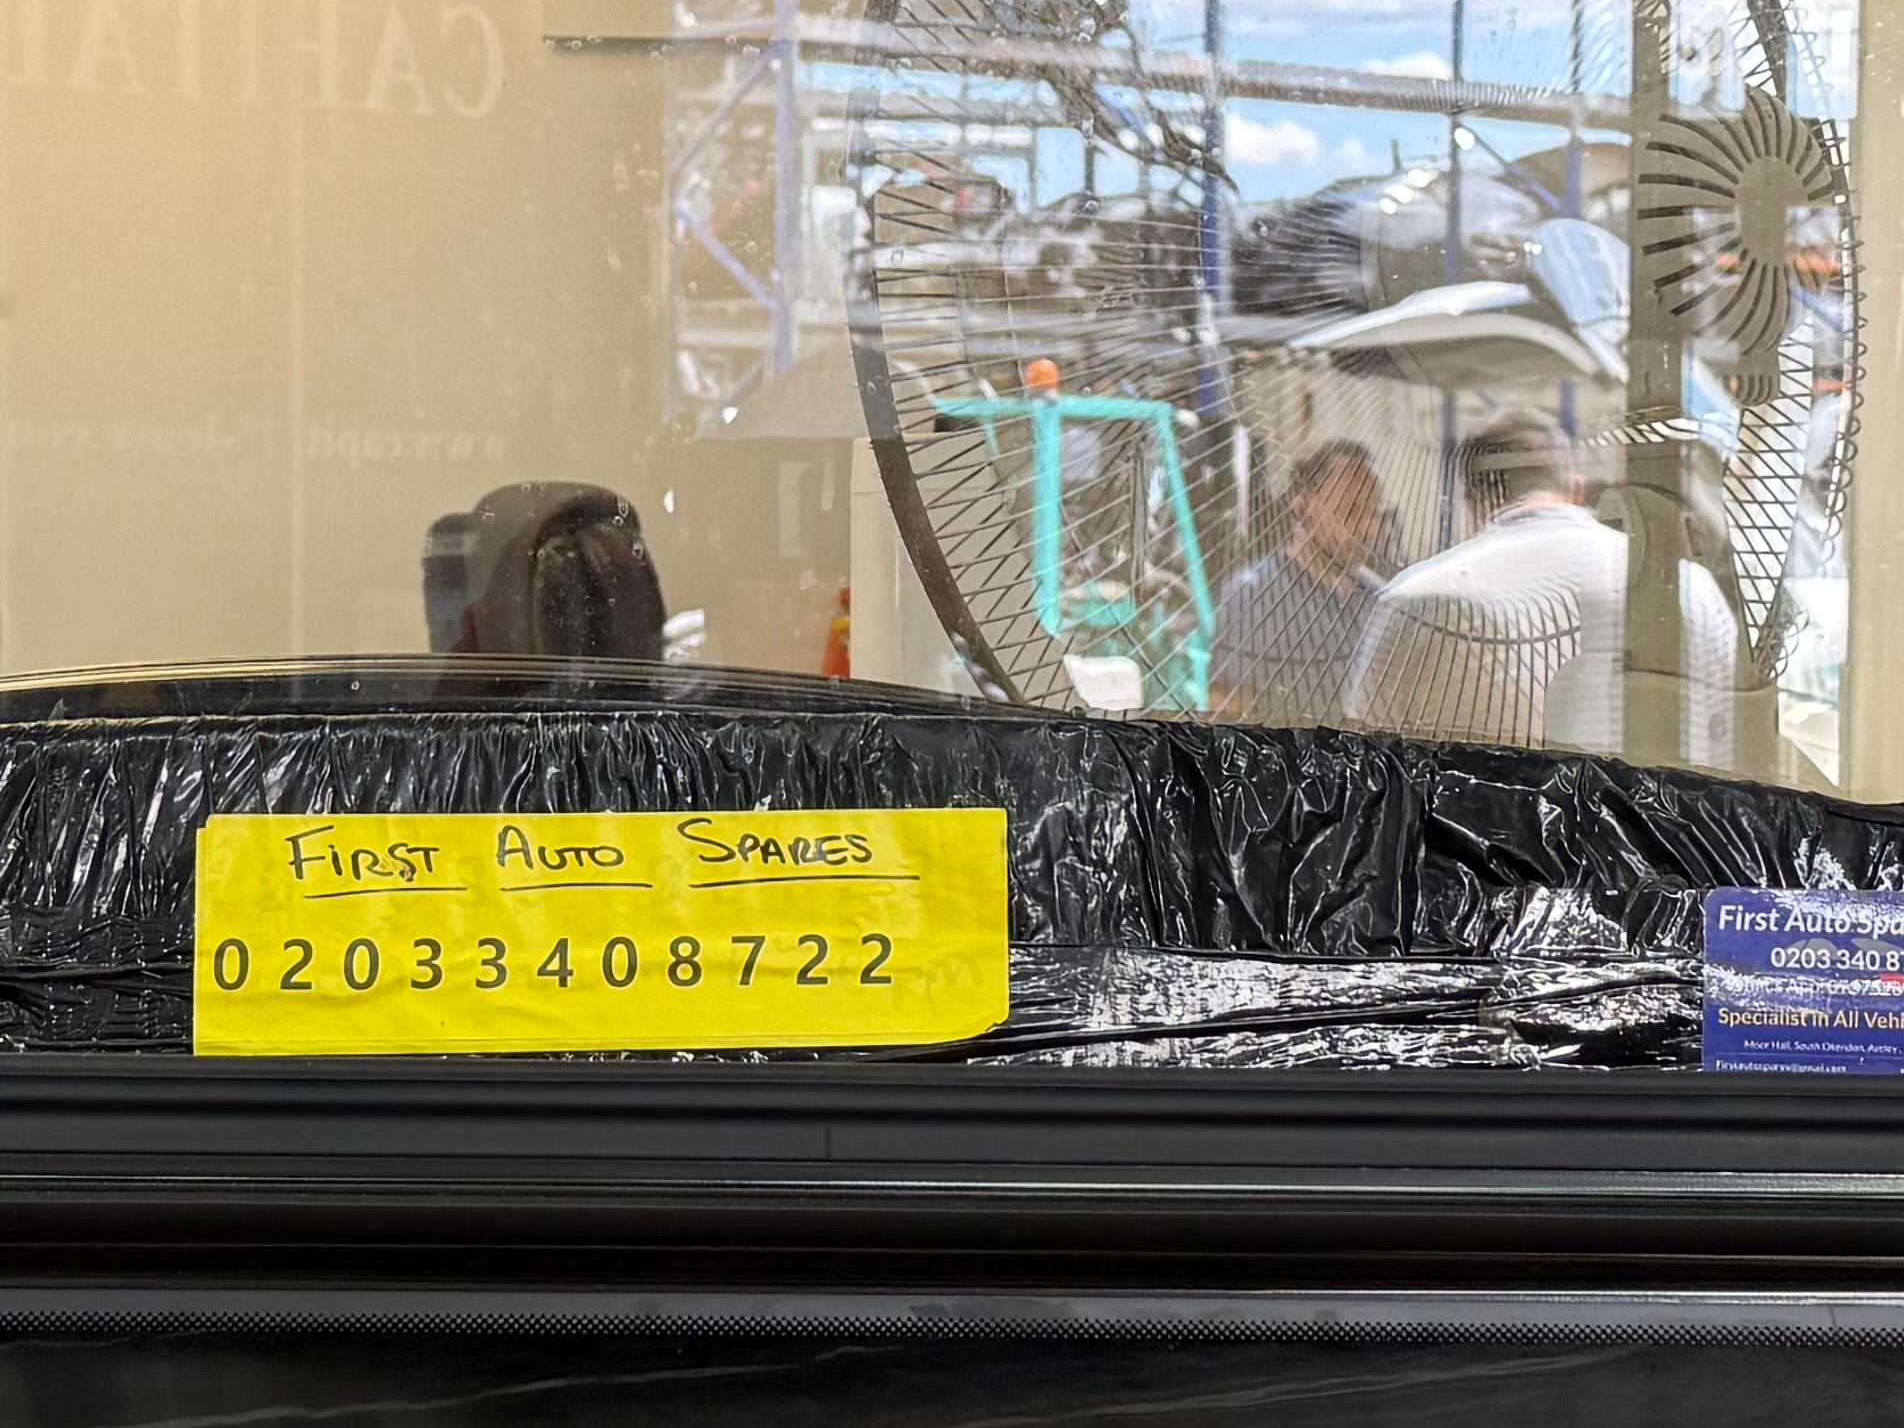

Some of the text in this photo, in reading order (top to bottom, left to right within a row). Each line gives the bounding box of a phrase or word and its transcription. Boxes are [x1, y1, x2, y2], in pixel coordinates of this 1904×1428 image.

[496, 824, 625, 871] AUTO
[676, 817, 874, 867] SPARES
[1718, 904, 1781, 931] First
[1784, 906, 1851, 934] Auto
[1770, 946, 1832, 969] 0203
[1836, 948, 1881, 971] 340
[1718, 1007, 1807, 1028] Specialist
[1811, 1011, 1829, 1028] in
[1833, 1009, 1859, 1029] All
